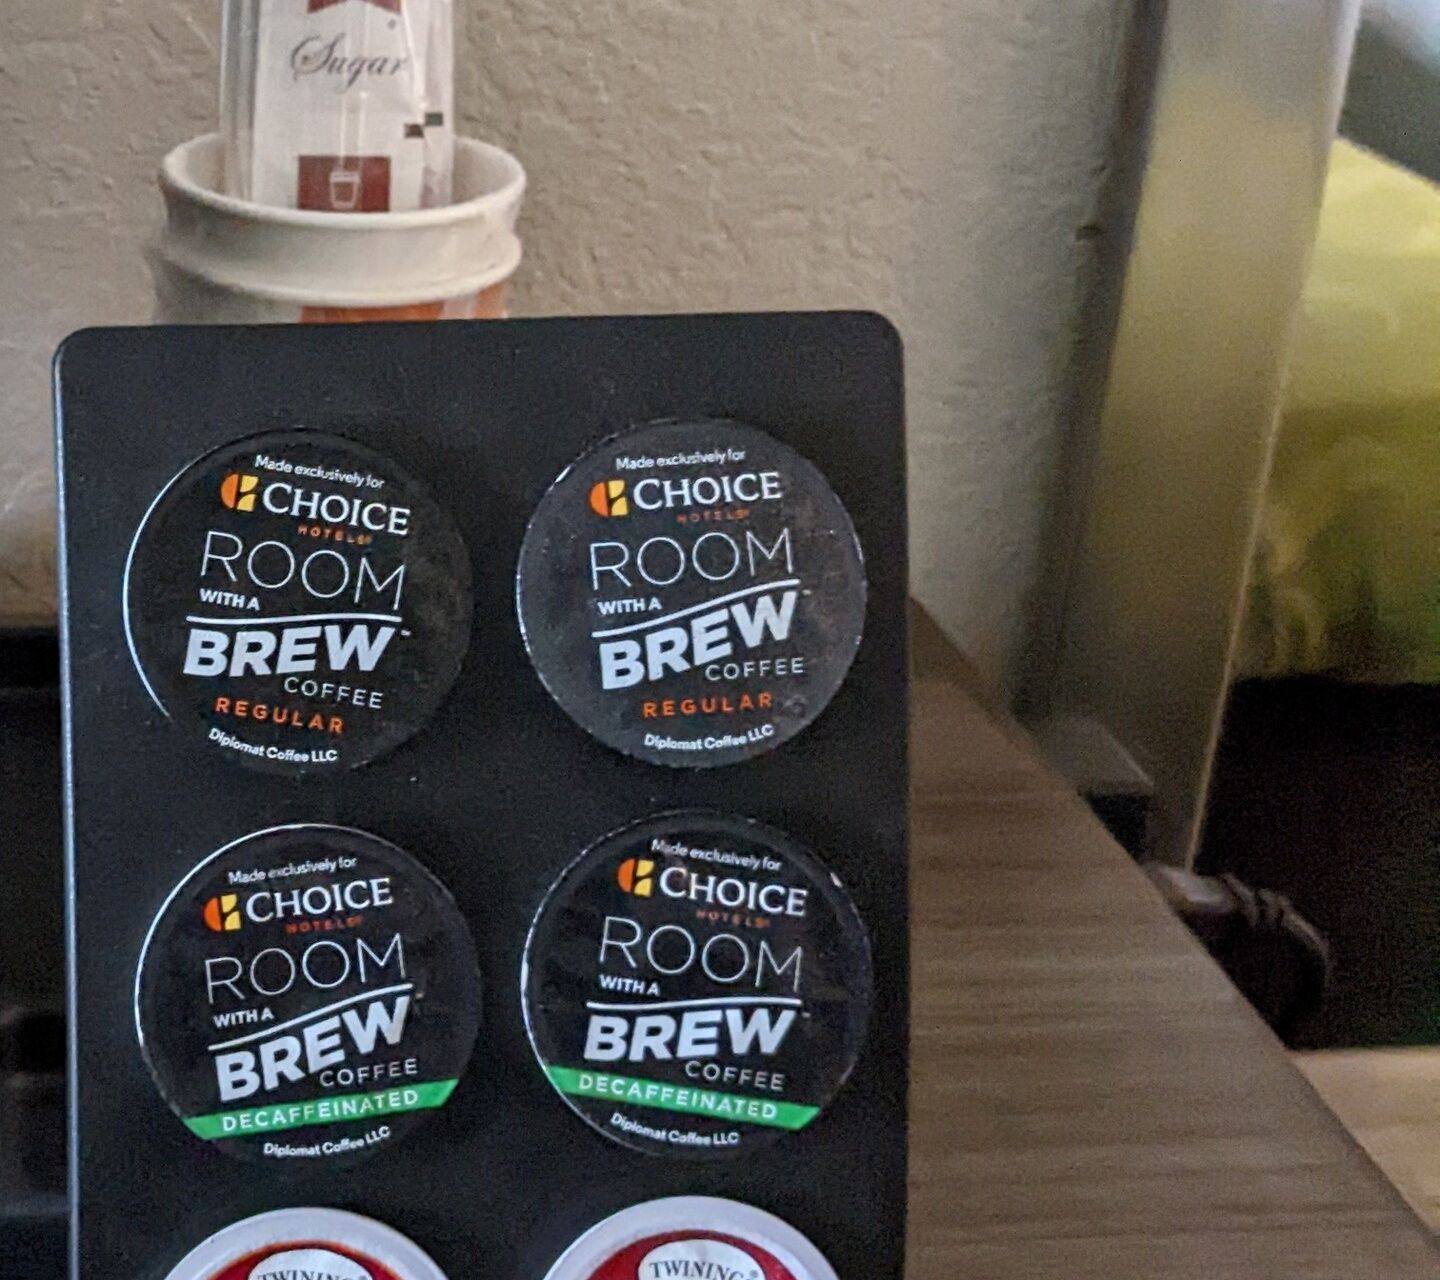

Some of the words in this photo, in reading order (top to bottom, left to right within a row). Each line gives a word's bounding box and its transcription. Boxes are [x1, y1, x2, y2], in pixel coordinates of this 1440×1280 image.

[290, 32, 408, 93] Sugar
[255, 454, 293, 473] Made
[294, 465, 365, 488] exclusively
[366, 475, 385, 489] for
[616, 455, 654, 470] Made
[657, 449, 726, 467] exclusively
[727, 448, 746, 461] for
[262, 482, 411, 535] CHOICE
[633, 472, 783, 510] CHOICE
[200, 530, 406, 610] ROOM
[590, 527, 794, 591] ROOM
[200, 588, 246, 609] WITH
[246, 596, 260, 611] A
[597, 599, 647, 616] WITH
[648, 598, 662, 611] A
[183, 624, 396, 678] BREW
[599, 591, 797, 690] BREW
[705, 658, 805, 681] COFFEE
[284, 677, 384, 709] COFFEE
[642, 691, 773, 718] REGULAR
[215, 696, 345, 734] REGULAR
[209, 728, 265, 758] Diplomat
[266, 745, 309, 763] Coffee
[312, 750, 338, 762] LLC
[644, 732, 703, 751] Diplomat
[705, 733, 748, 751] Coffee
[749, 725, 774, 742] LLC
[228, 869, 266, 884] Made
[268, 857, 336, 879] exclusively
[338, 856, 357, 869] for
[651, 838, 689, 856] Made
[689, 848, 761, 870] exclusively
[762, 856, 782, 871] for
[246, 877, 394, 923] CHOICE
[660, 866, 809, 917] CHOICE
[205, 933, 406, 1005] ROOM
[599, 916, 803, 992] ROOM
[599, 974, 645, 994] WITH
[646, 982, 660, 996] A
[213, 1009, 261, 1028] WITH
[261, 1007, 274, 1021] A
[215, 995, 410, 1103] BREW
[583, 1008, 797, 1063] BREW
[320, 1058, 418, 1088] COFFEE
[685, 1060, 785, 1093] COFFEE
[221, 1090, 419, 1132] DECAFFEINATED
[578, 1074, 778, 1120] DECAFFEINATED
[264, 1141, 321, 1158] Diplomat
[322, 1136, 365, 1155] Coffee
[366, 1125, 391, 1144] LLC
[610, 1112, 666, 1141] Diplomat
[668, 1129, 711, 1146] Coffee
[713, 1131, 739, 1145] LLC
